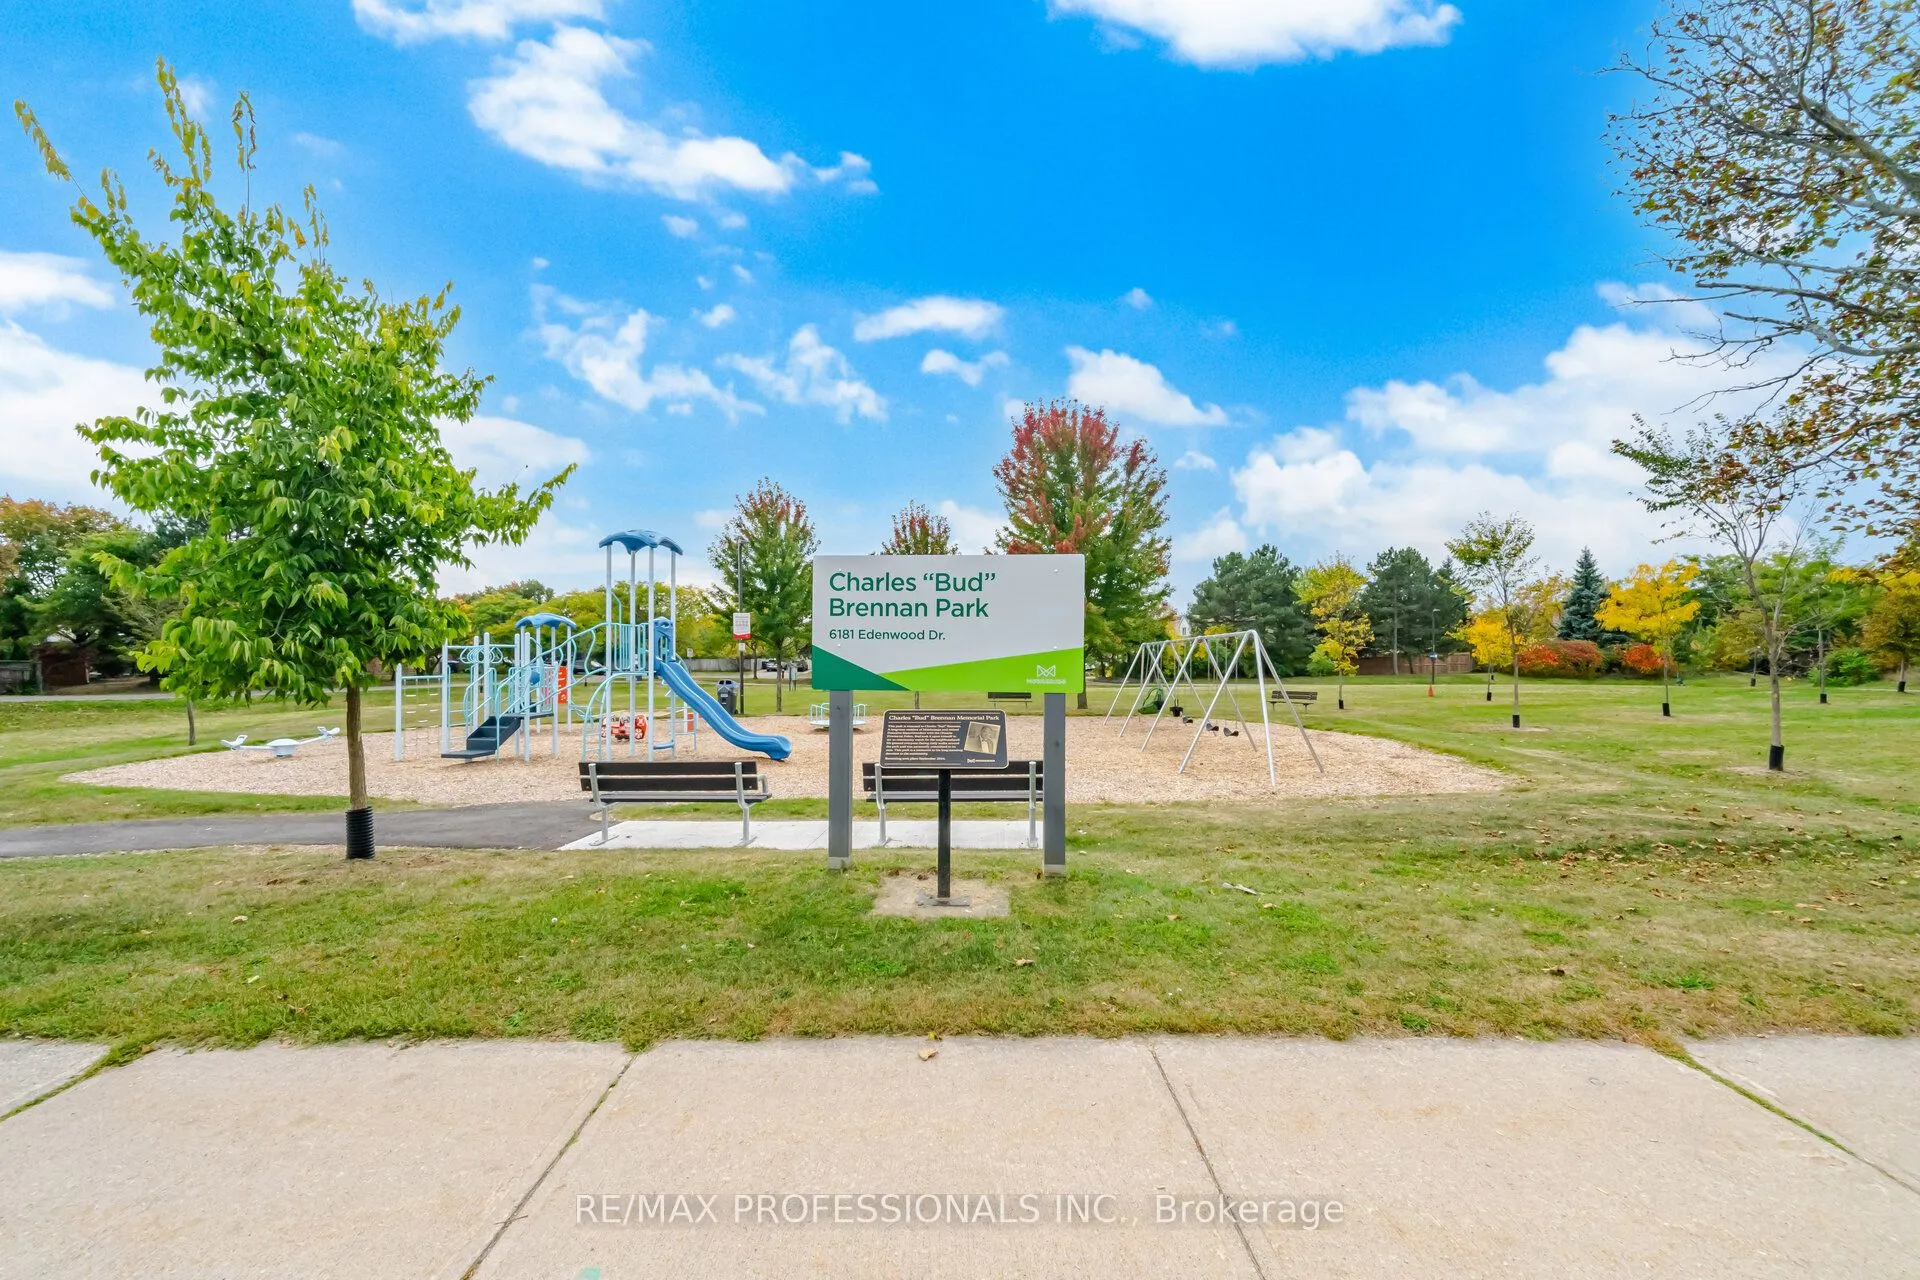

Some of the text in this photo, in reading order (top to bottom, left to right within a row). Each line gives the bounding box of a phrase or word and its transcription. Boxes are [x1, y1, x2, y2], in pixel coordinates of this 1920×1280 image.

[829, 572, 996, 592] Charles “Bud”
[829, 598, 989, 617] Brennan Park
[829, 629, 946, 641] 6181 Edenwood Dr.
